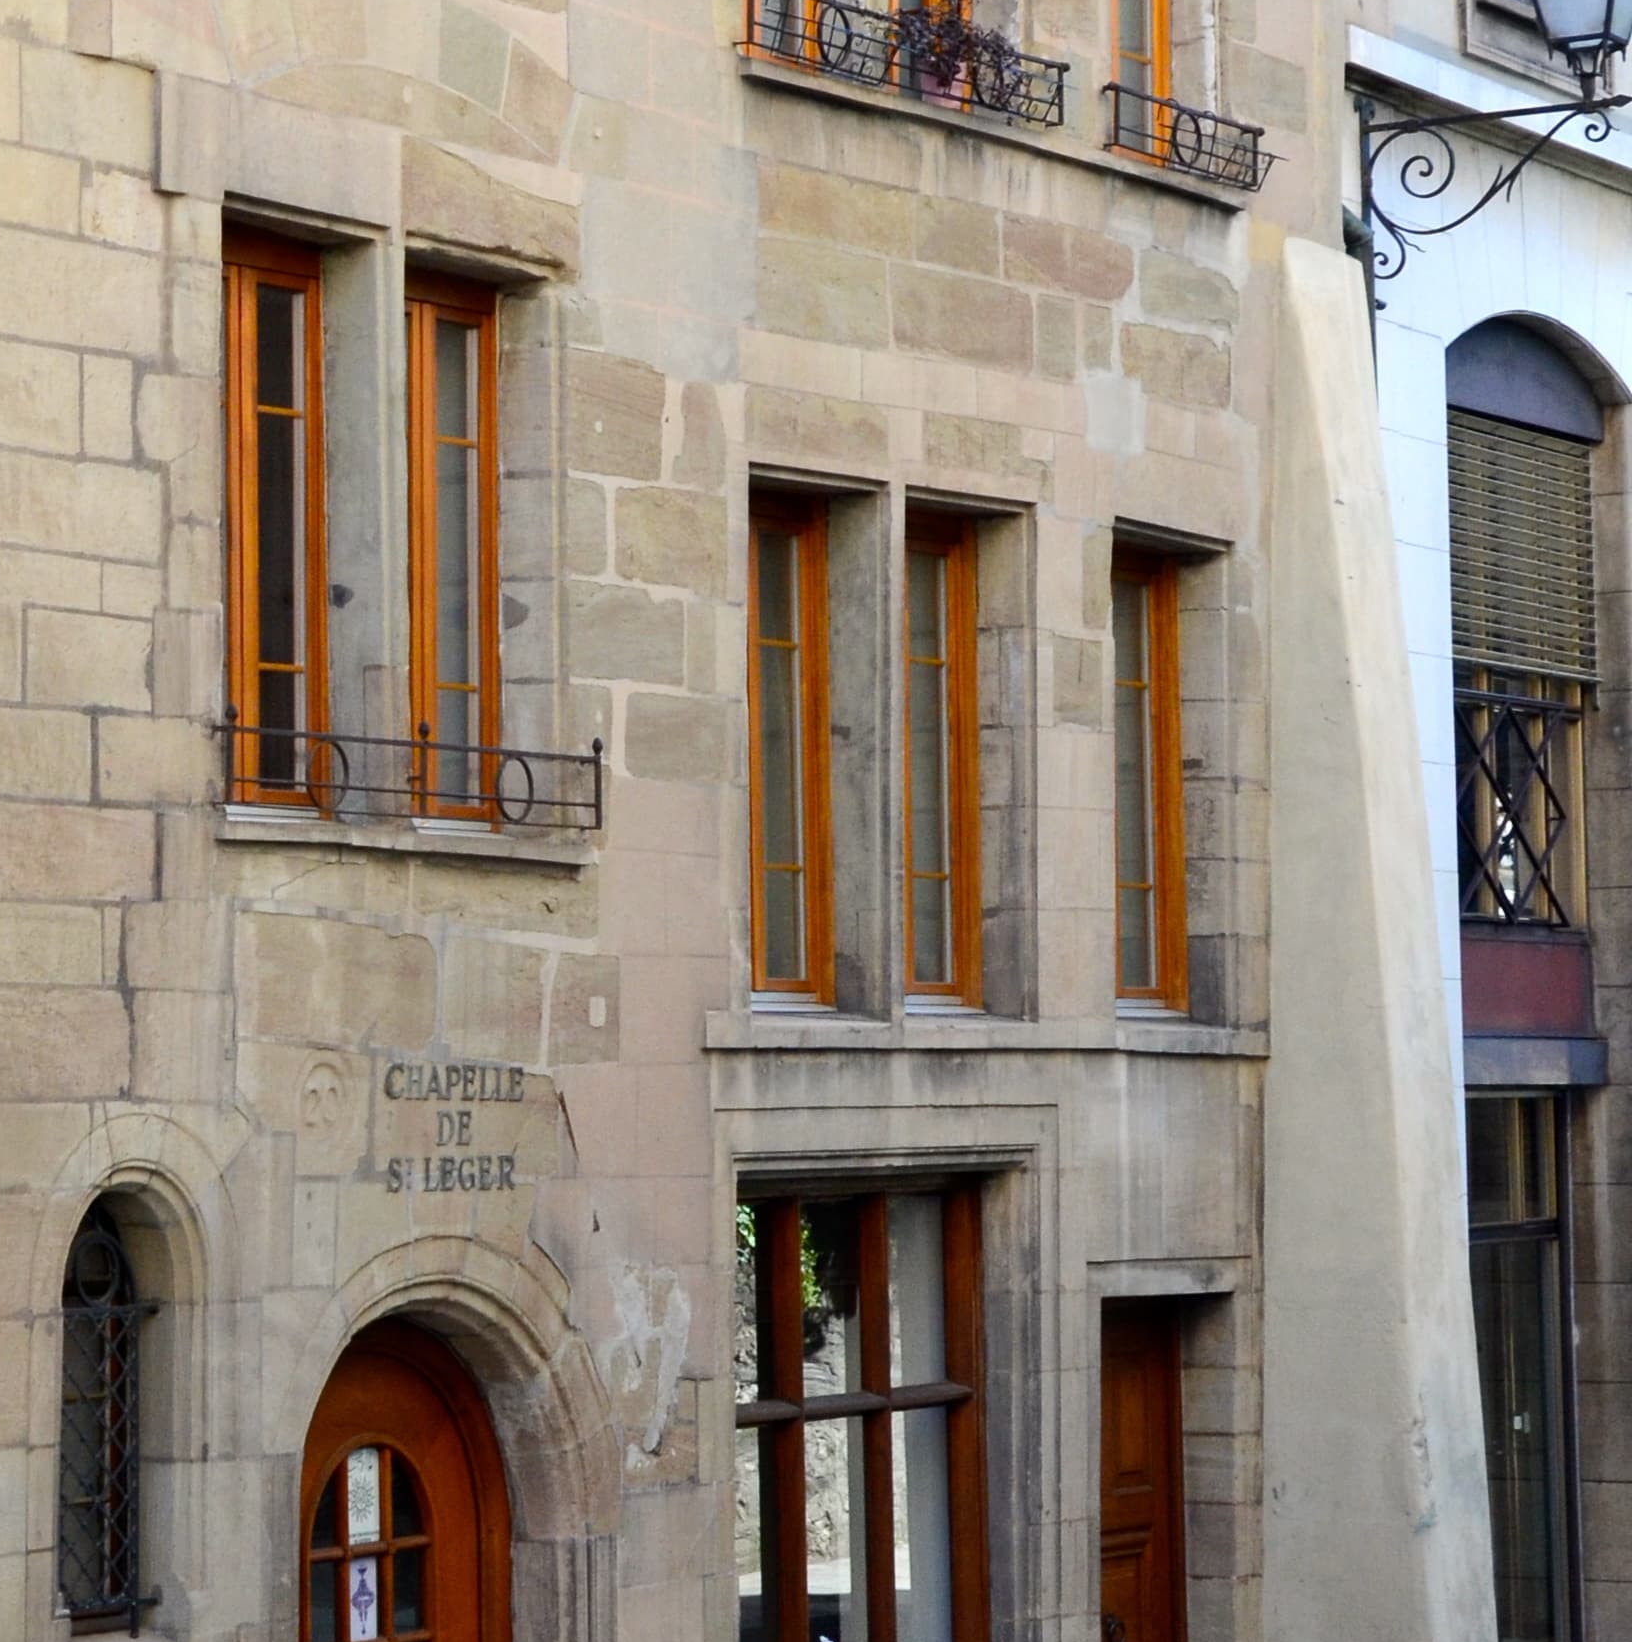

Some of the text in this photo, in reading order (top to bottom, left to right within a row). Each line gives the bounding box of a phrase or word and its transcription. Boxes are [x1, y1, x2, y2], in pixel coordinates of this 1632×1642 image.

[383, 1063, 525, 1102] CHAPELLE
[435, 1111, 473, 1147] DE
[423, 1155, 517, 1192] LEGER
